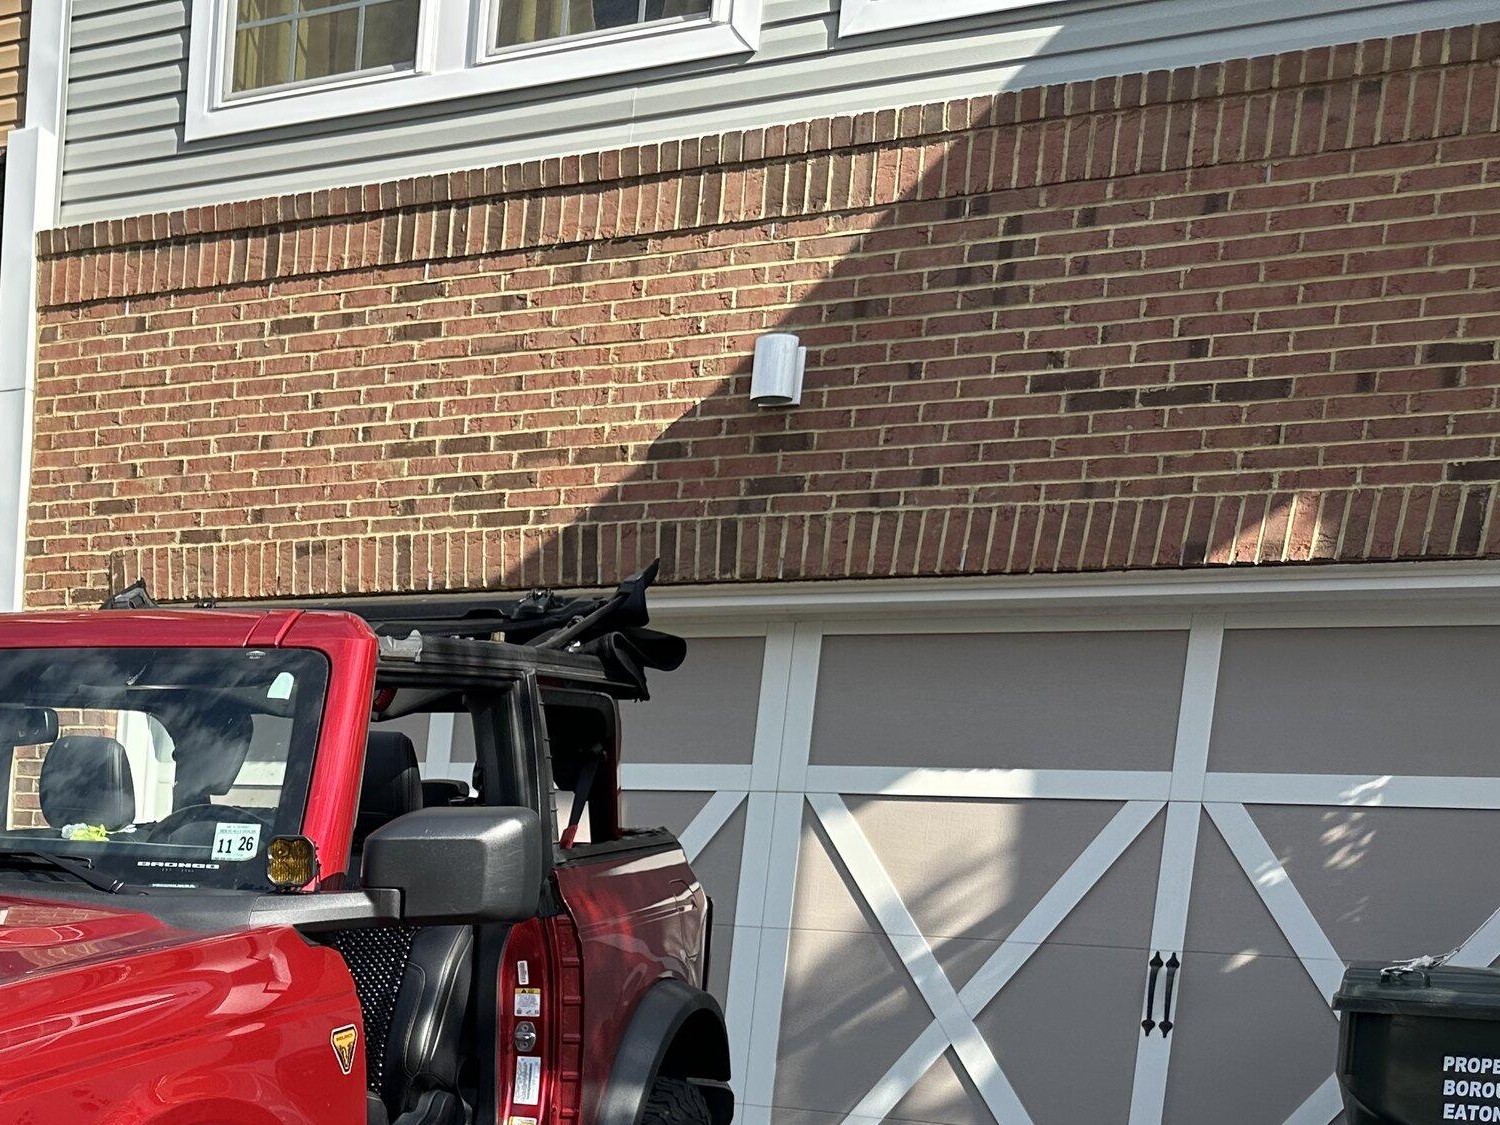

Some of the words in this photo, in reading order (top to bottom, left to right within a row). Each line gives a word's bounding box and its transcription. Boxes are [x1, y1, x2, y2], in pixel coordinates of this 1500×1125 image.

[217, 838, 233, 854] 11
[238, 836, 254, 852] 26
[137, 861, 220, 870] BRONCO
